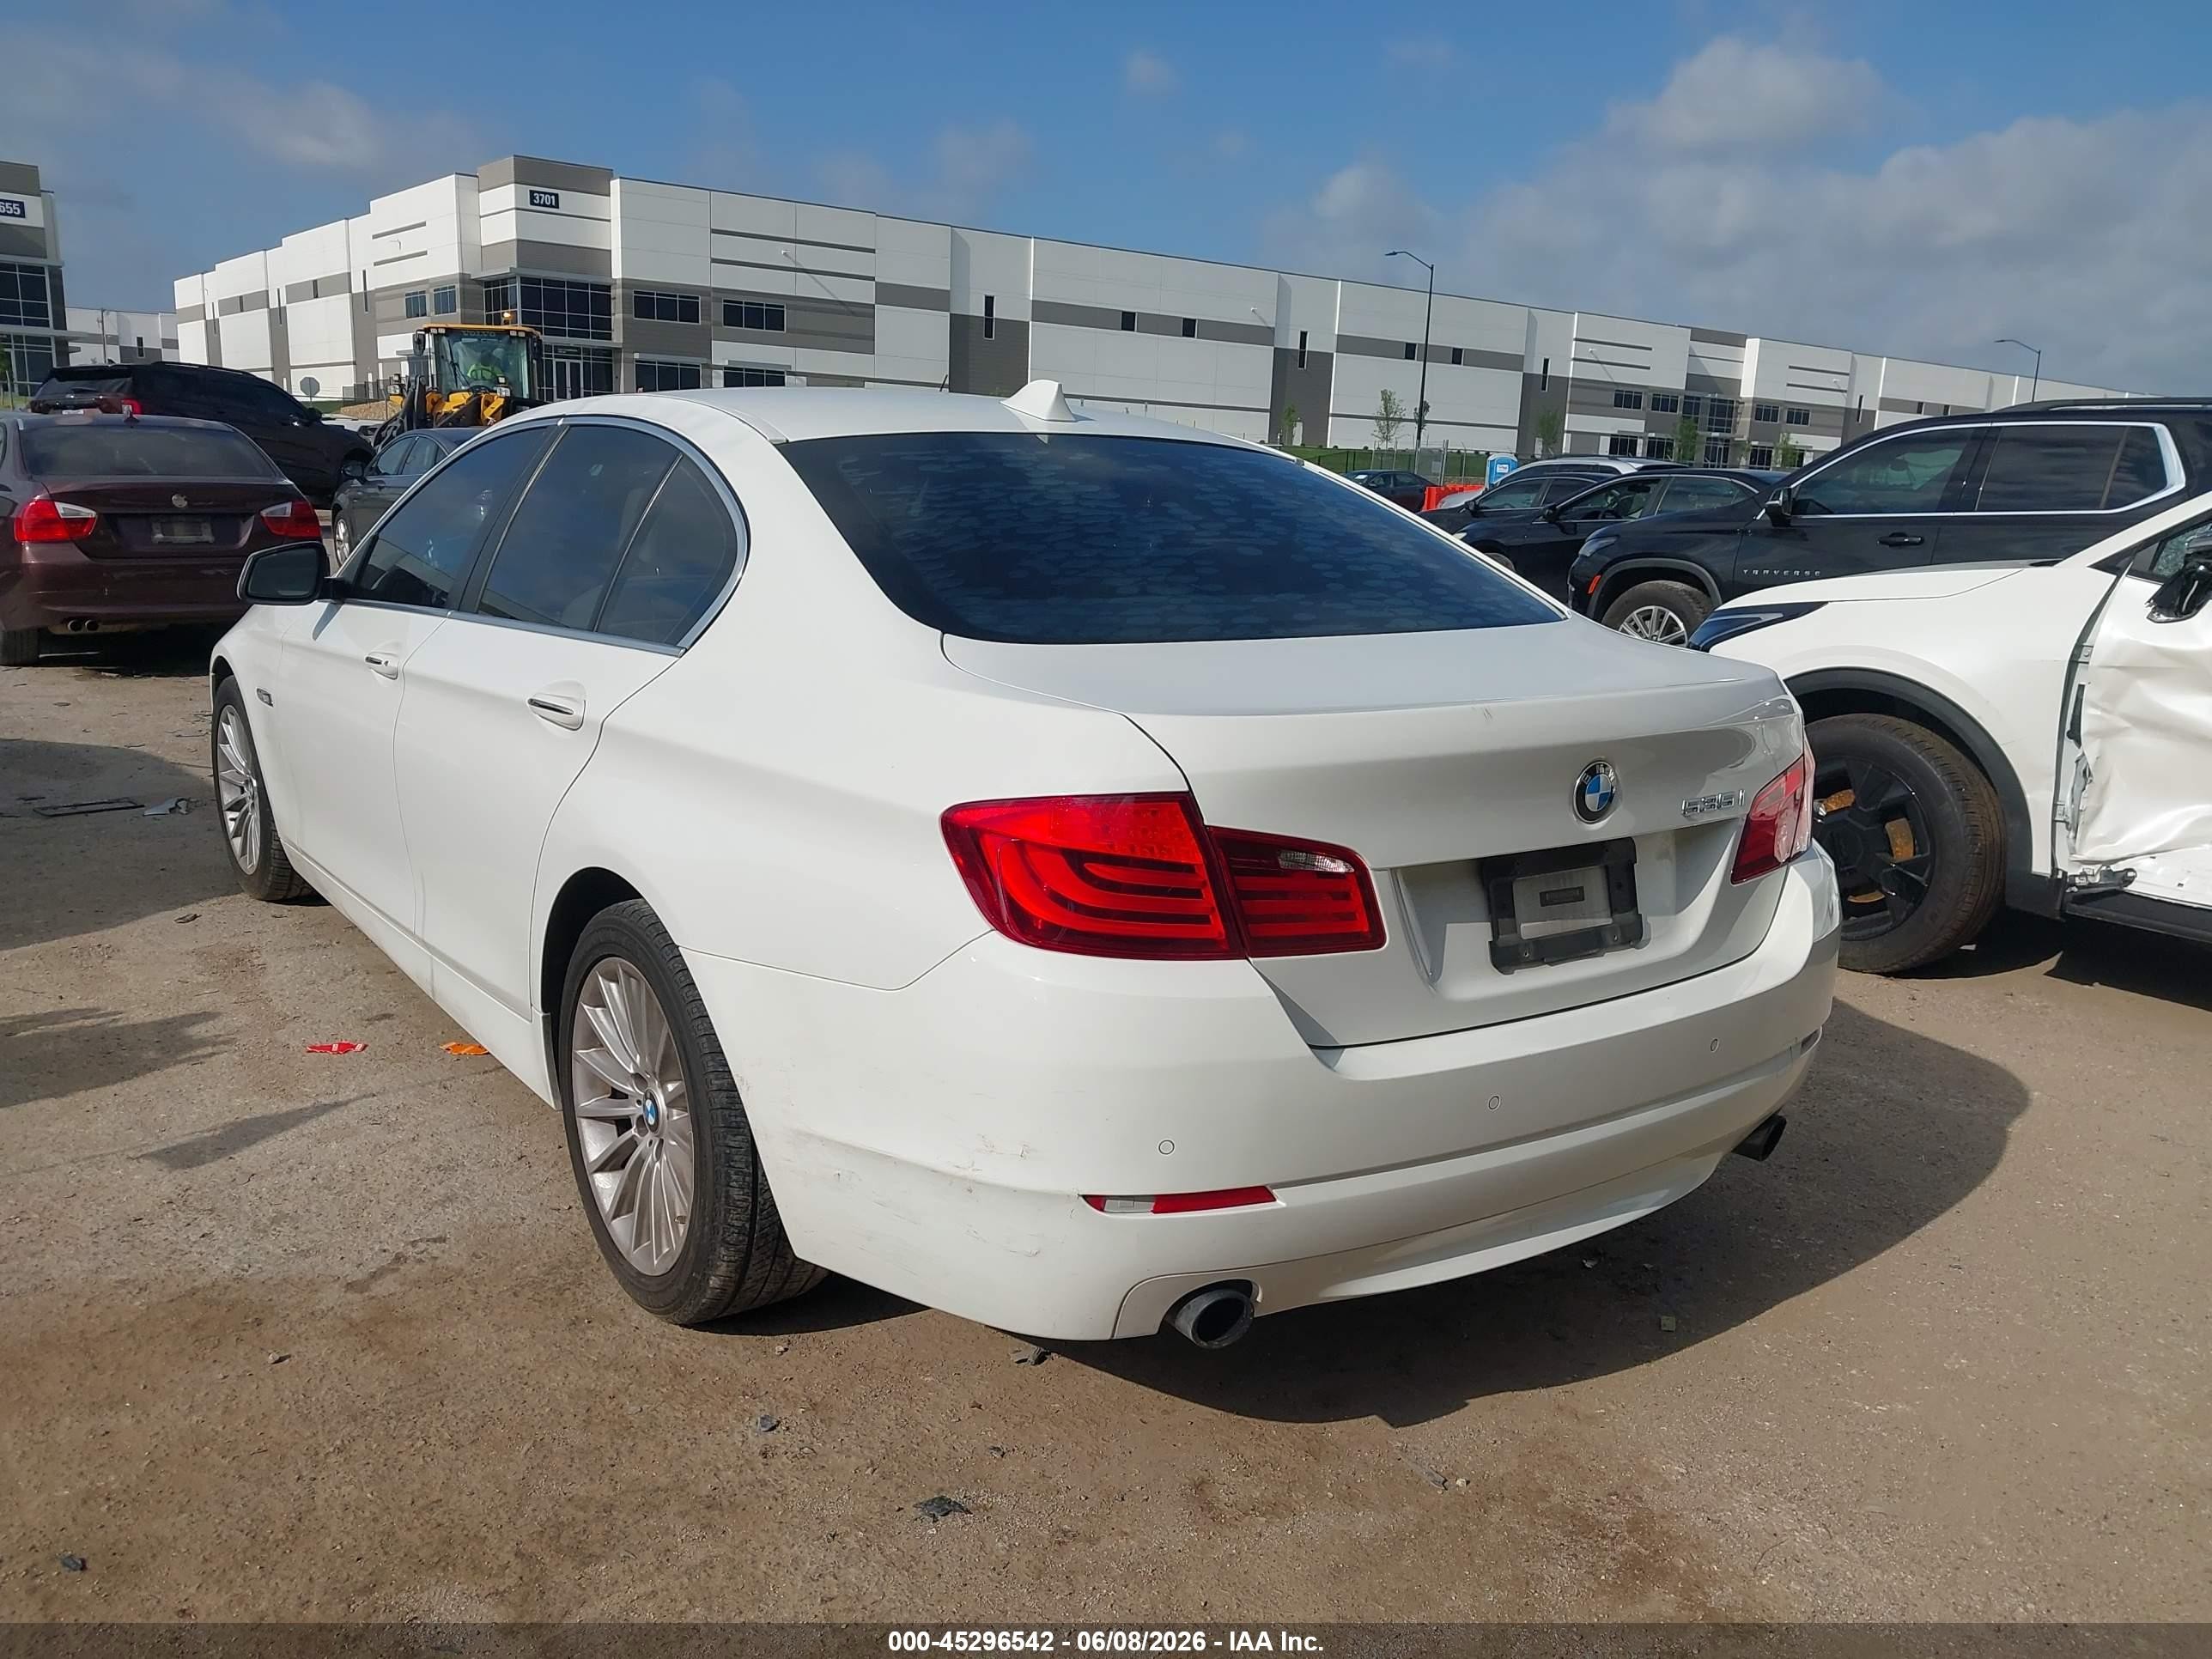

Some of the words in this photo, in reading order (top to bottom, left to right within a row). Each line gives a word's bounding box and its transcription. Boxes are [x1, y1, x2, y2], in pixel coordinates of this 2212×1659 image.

[533, 192, 556, 206] 3701
[0, 201, 21, 215] 655
[1582, 763, 1614, 785] BMW
